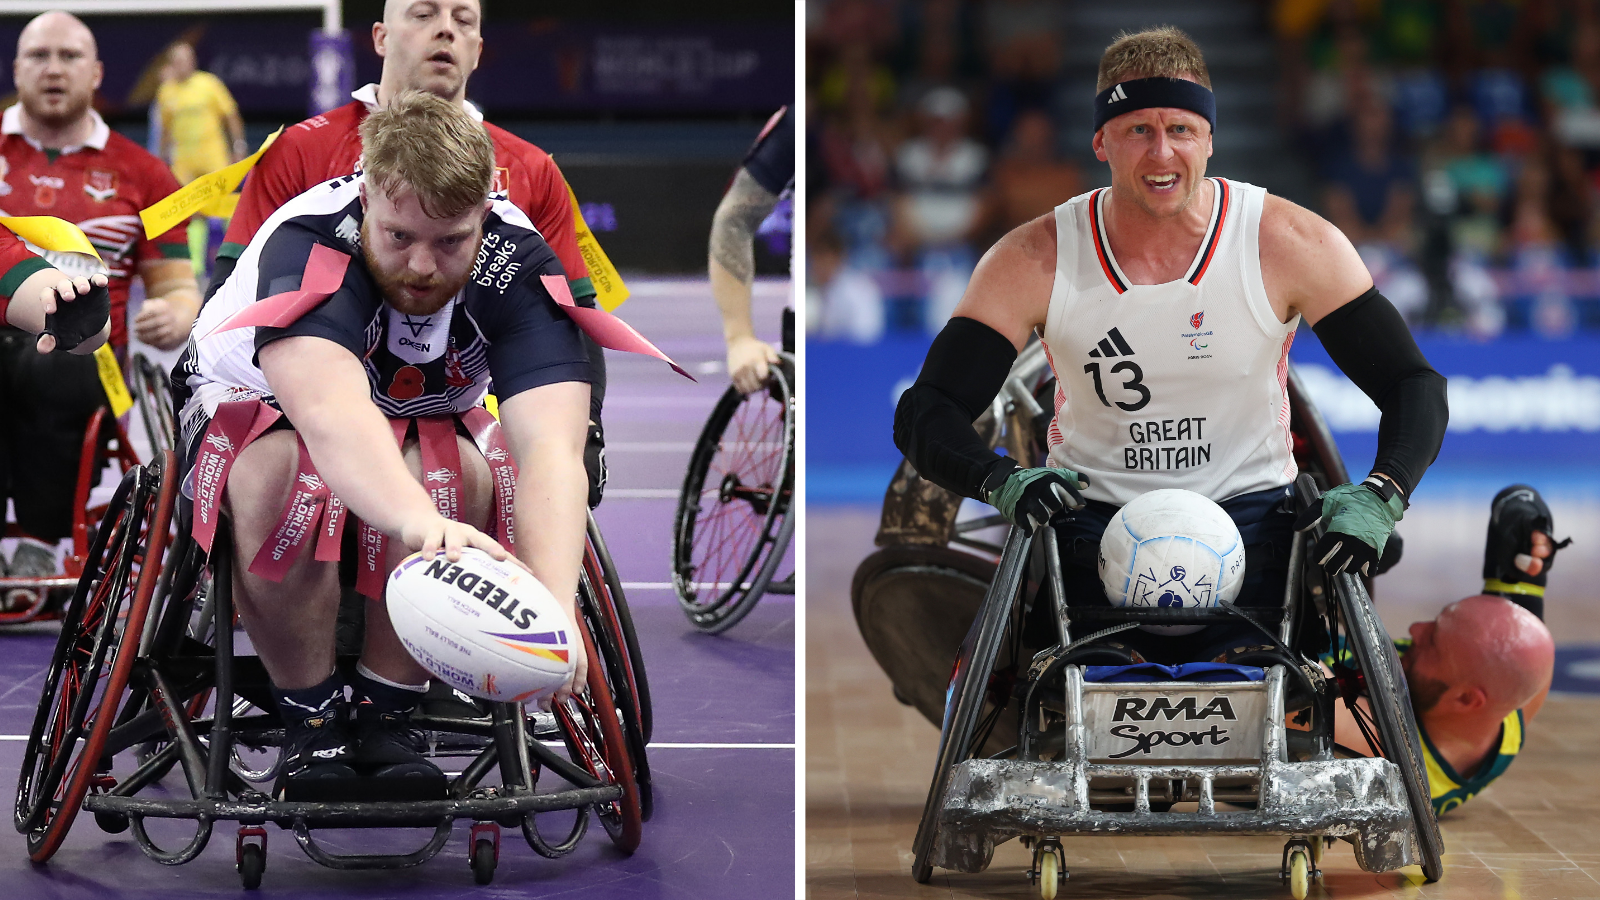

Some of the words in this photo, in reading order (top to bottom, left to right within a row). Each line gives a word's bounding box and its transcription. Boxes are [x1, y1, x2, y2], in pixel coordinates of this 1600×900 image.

[476, 240, 517, 287] breaks
[496, 262, 522, 295] .com
[398, 337, 431, 353] OXEN
[1084, 360, 1152, 412] 13
[1129, 416, 1207, 444] GREAT
[212, 457, 226, 482] RUGBY
[1124, 443, 1212, 471] BRITAIN
[200, 453, 221, 500] WORLD
[499, 465, 514, 514] WORLD
[208, 480, 218, 509] LEAGUE
[438, 486, 451, 519] WOR
[449, 487, 458, 513] RUGBY
[199, 499, 209, 524] CUP
[284, 492, 313, 538] WORLD
[305, 503, 317, 523] GBY
[327, 512, 338, 537] CUP
[506, 516, 515, 544] CUP
[272, 537, 290, 561] CUP
[366, 548, 376, 572] CUP
[423, 559, 538, 630] STEEDEN
[425, 657, 475, 687] WORLD
[1110, 696, 1238, 722] RMA
[1108, 724, 1231, 759] Sport
